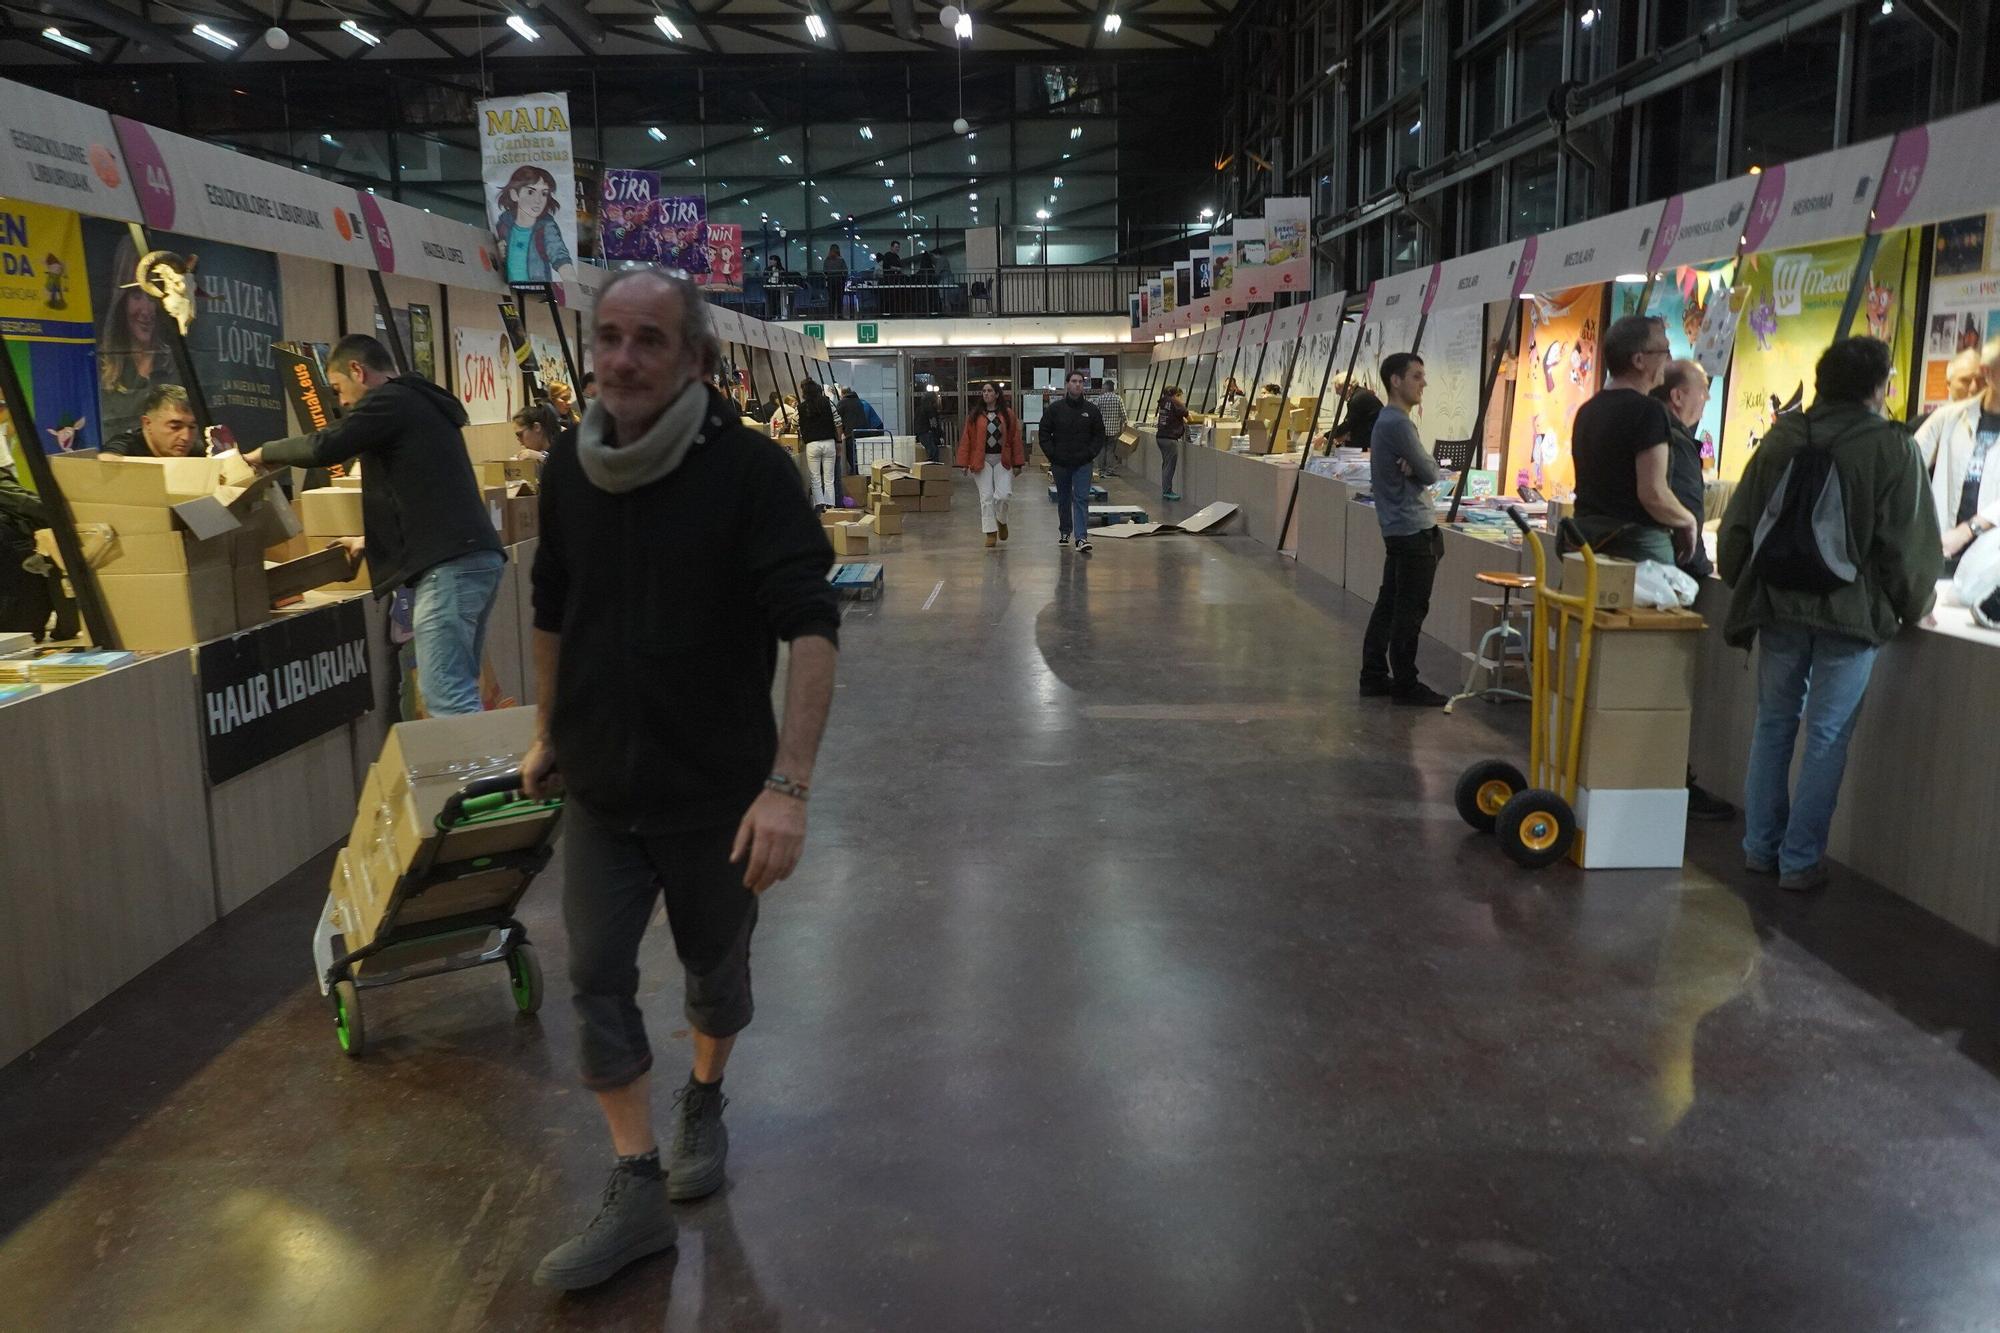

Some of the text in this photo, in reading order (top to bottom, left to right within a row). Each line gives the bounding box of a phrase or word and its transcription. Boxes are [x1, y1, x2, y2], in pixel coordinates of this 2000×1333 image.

[485, 106, 569, 136] MAIA
[146, 164, 170, 196] 44
[204, 183, 325, 230] EGUZKILORE LIBURUAK
[3, 251, 35, 277] DA
[204, 274, 279, 327] HAIZEA
[215, 320, 276, 370] LÓPEZ
[206, 638, 367, 737] HAUR LIBURUAK
